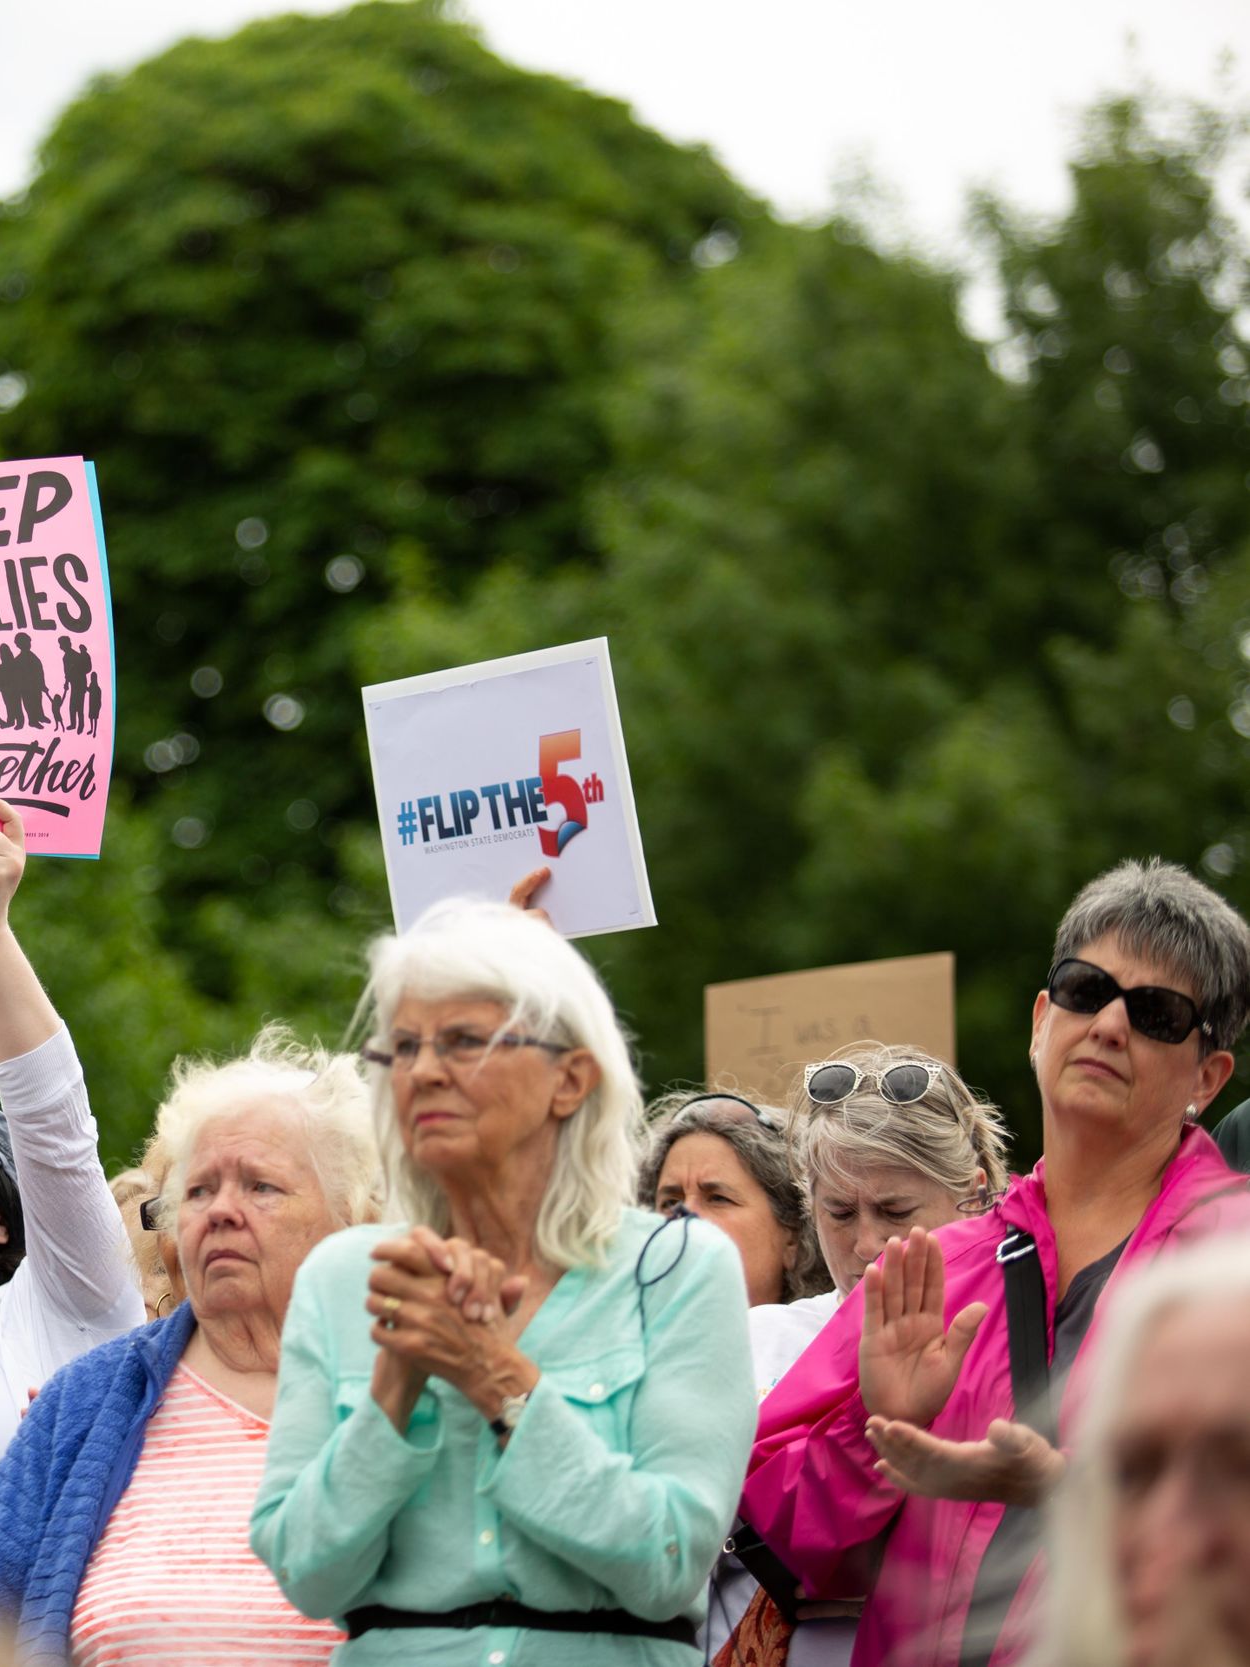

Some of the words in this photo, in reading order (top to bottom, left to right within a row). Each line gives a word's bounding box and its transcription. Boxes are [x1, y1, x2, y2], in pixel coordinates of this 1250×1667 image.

[397, 789, 480, 846] #FLIP
[480, 776, 548, 830] THE
[537, 728, 604, 858] 5th
[424, 840, 469, 854] WASHINGTON
[471, 836, 491, 848] STATE
[493, 828, 535, 843] DEMOCRATS
